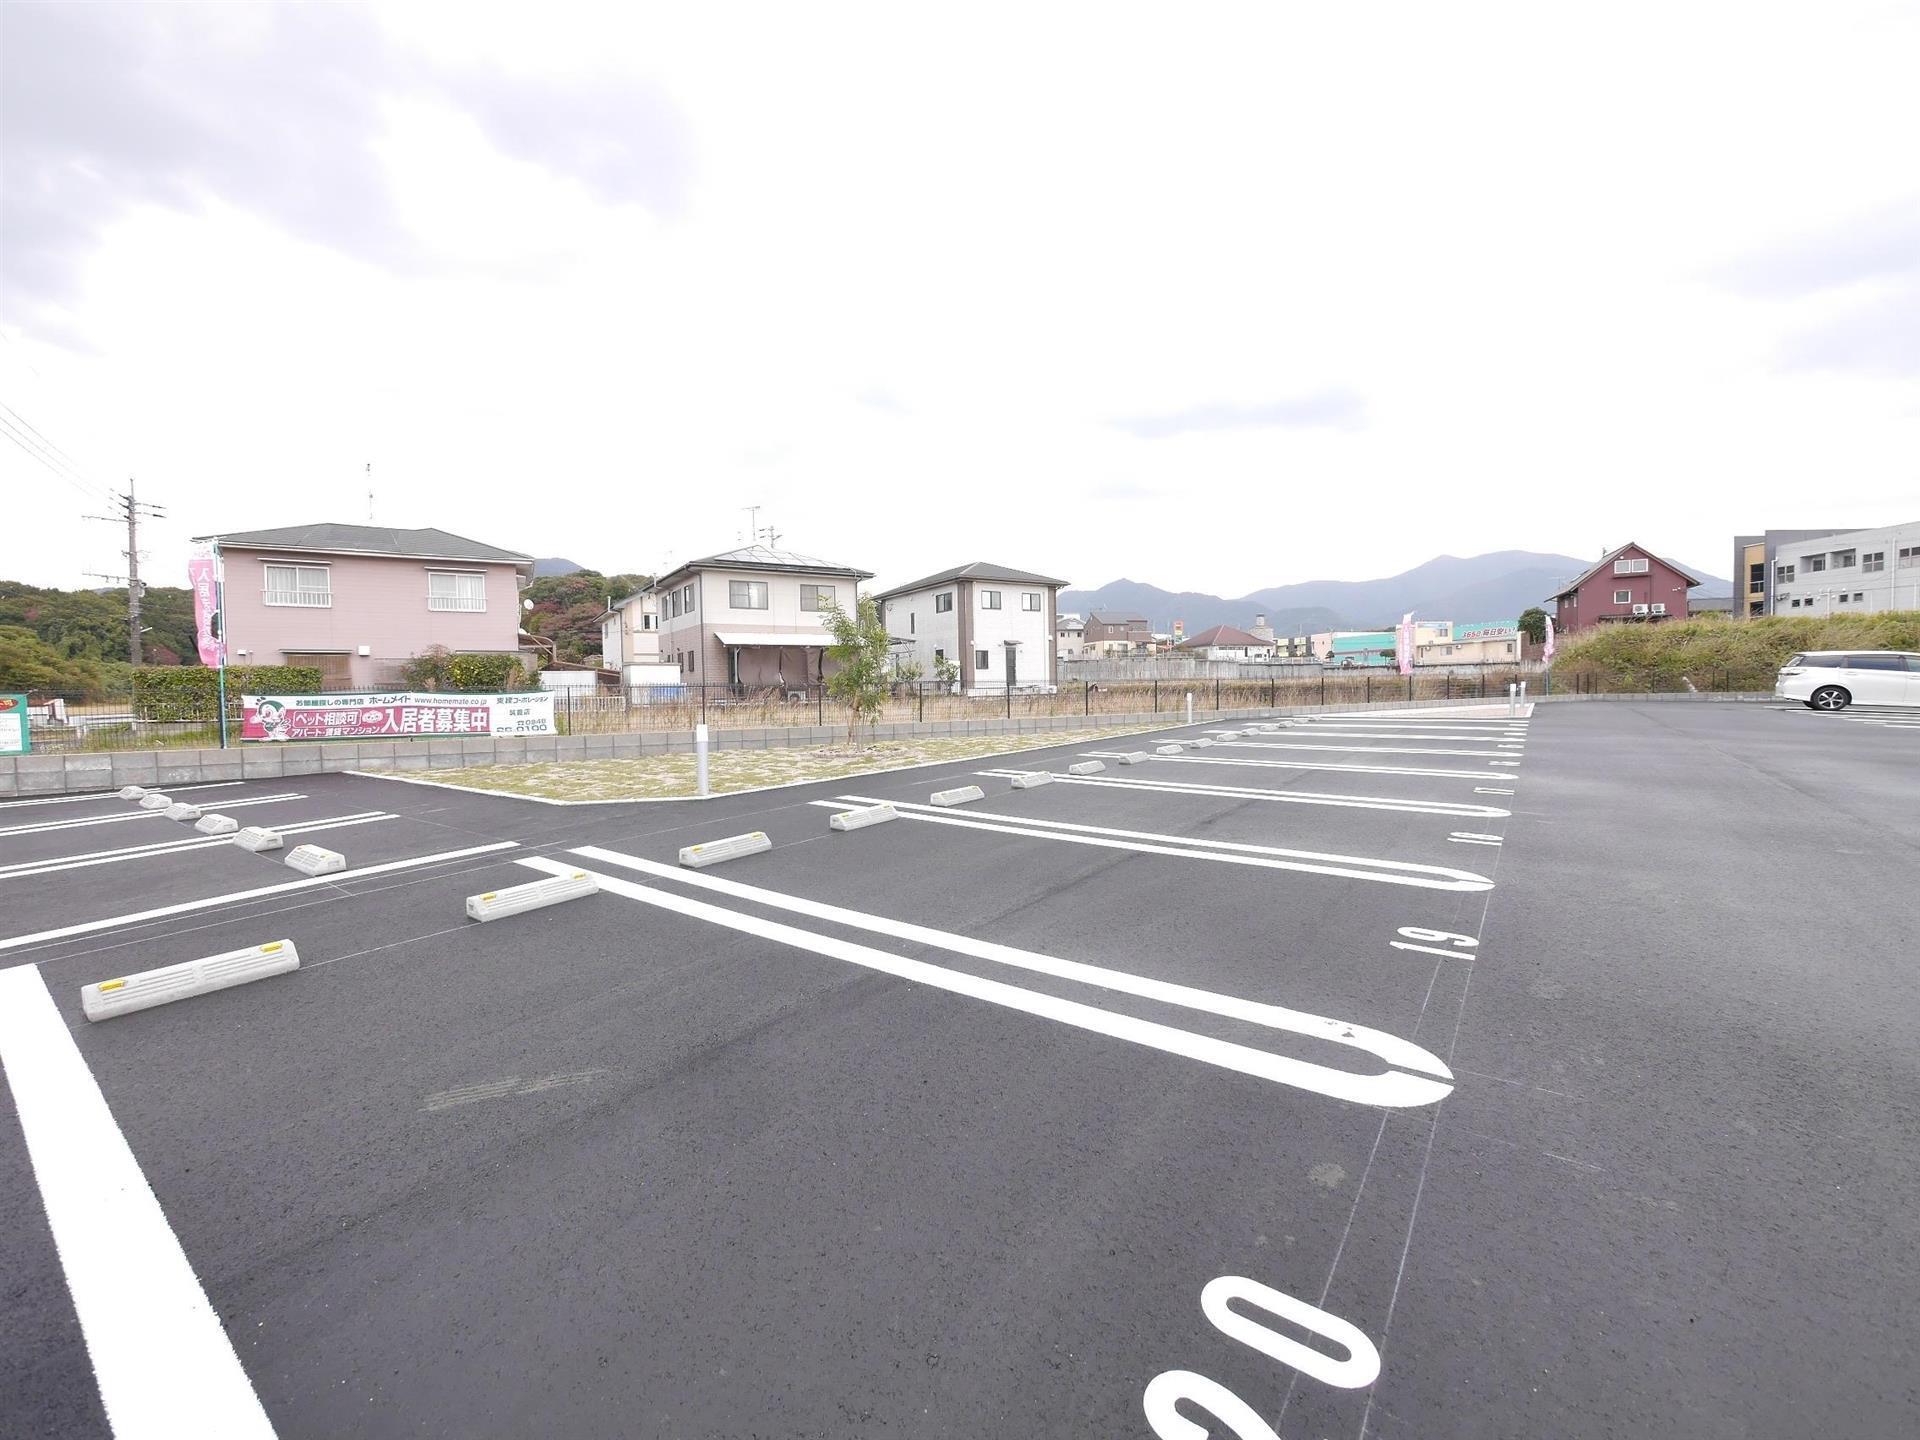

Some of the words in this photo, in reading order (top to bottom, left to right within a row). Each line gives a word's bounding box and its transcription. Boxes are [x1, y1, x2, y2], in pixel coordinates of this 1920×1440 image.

[296, 698, 364, 706] お部屋探しの専門店
[369, 695, 411, 704] ホームメイト
[295, 711, 359, 726] ペット相談可
[381, 707, 489, 733] 入居者募集中
[1447, 831, 1505, 846] 18
[1389, 926, 1480, 961] 19
